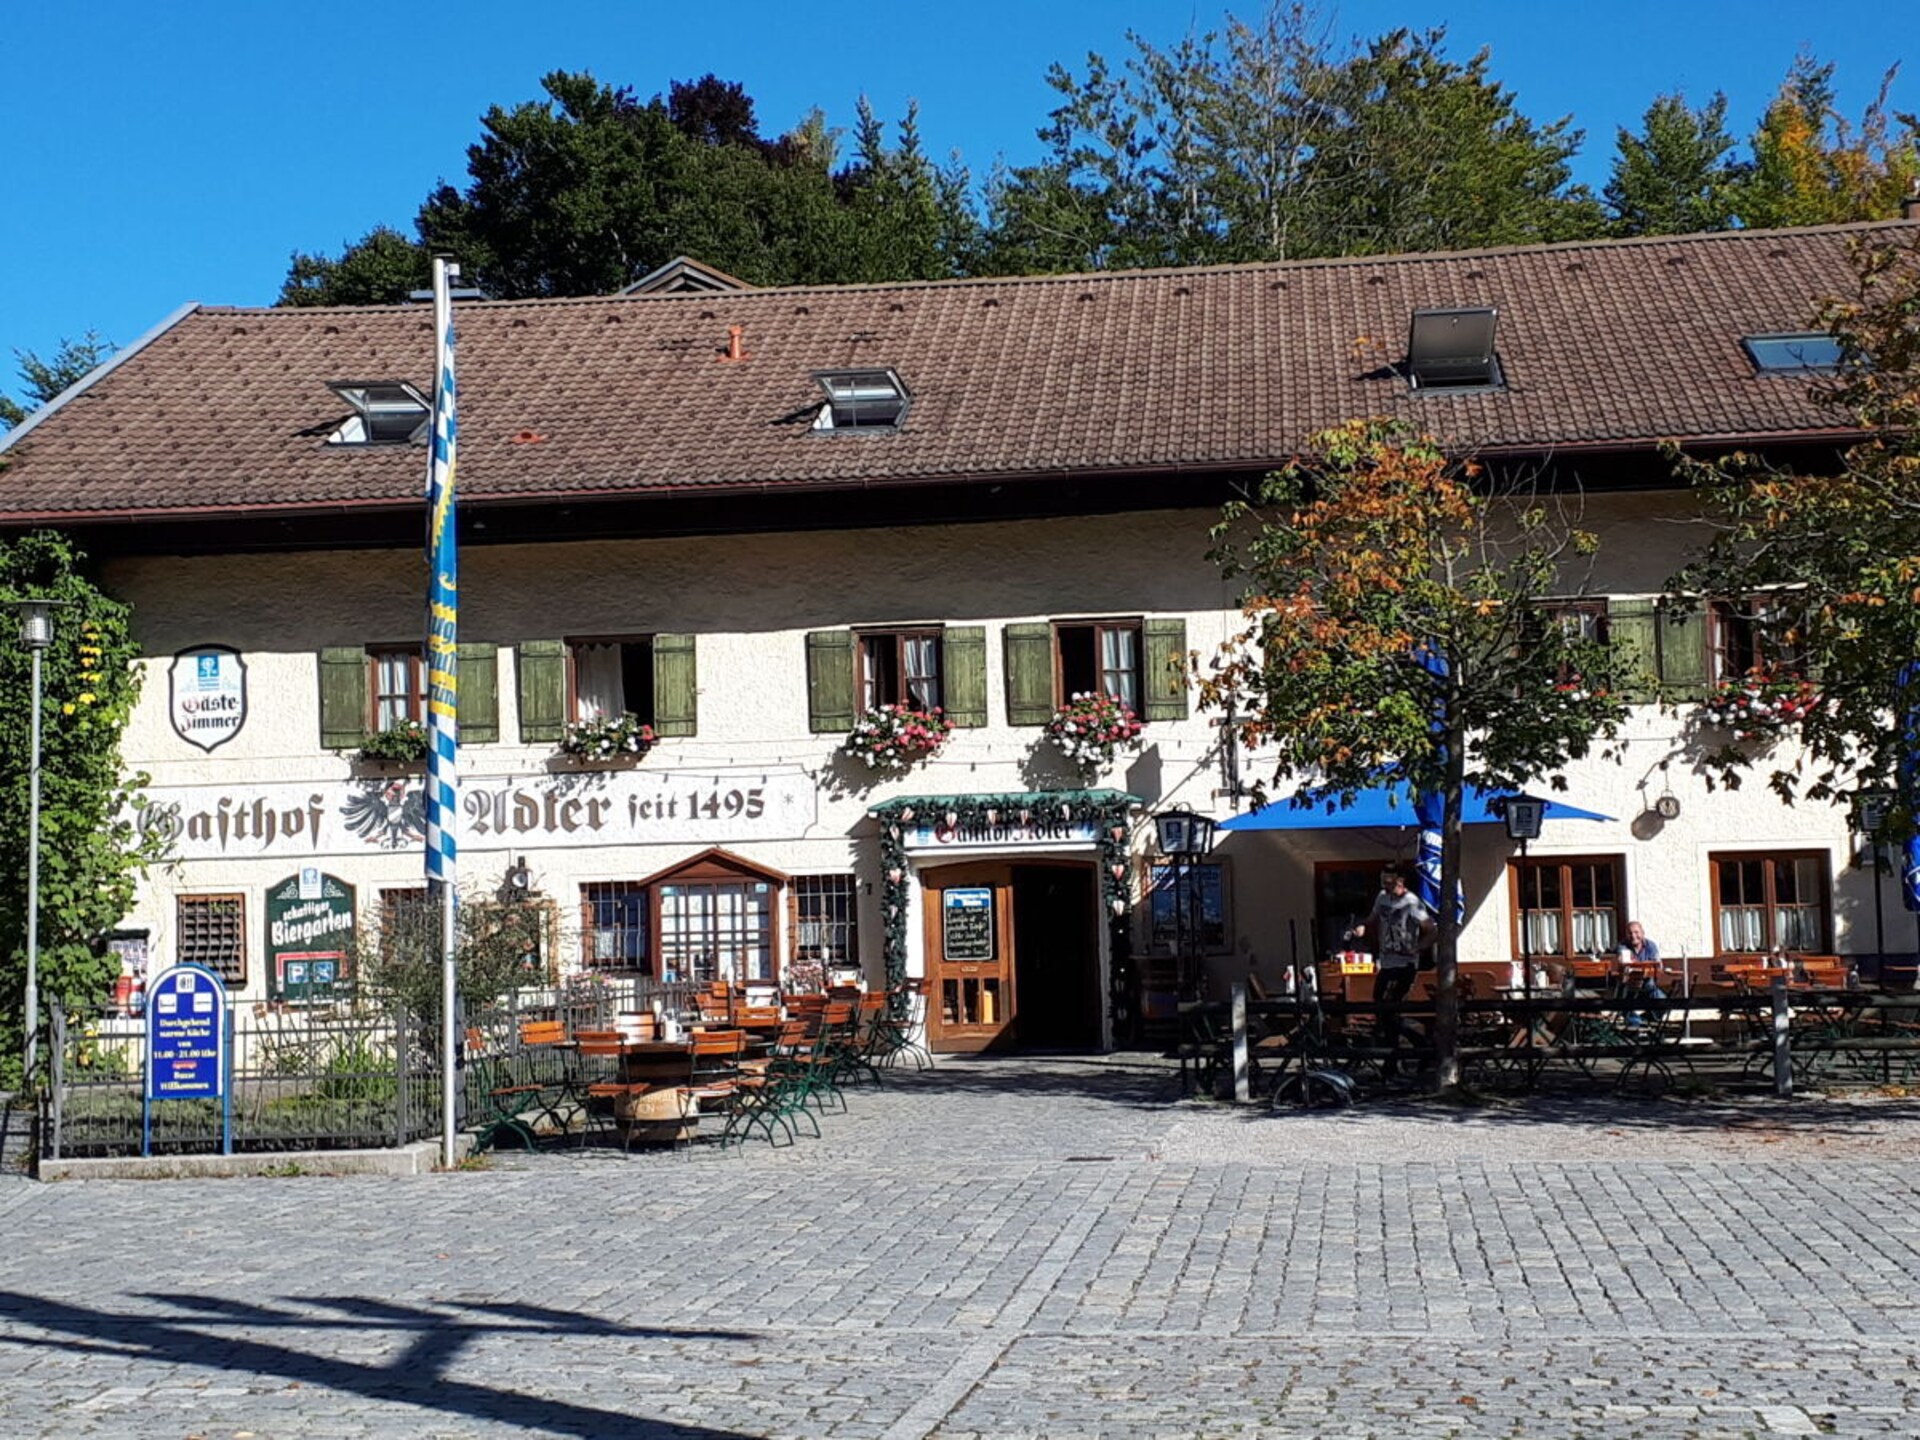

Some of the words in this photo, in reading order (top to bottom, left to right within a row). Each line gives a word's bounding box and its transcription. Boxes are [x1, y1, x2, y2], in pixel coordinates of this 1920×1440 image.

[463, 789, 612, 836] Adler
[687, 788, 765, 821] 1495
[271, 909, 352, 946] Biergarten
